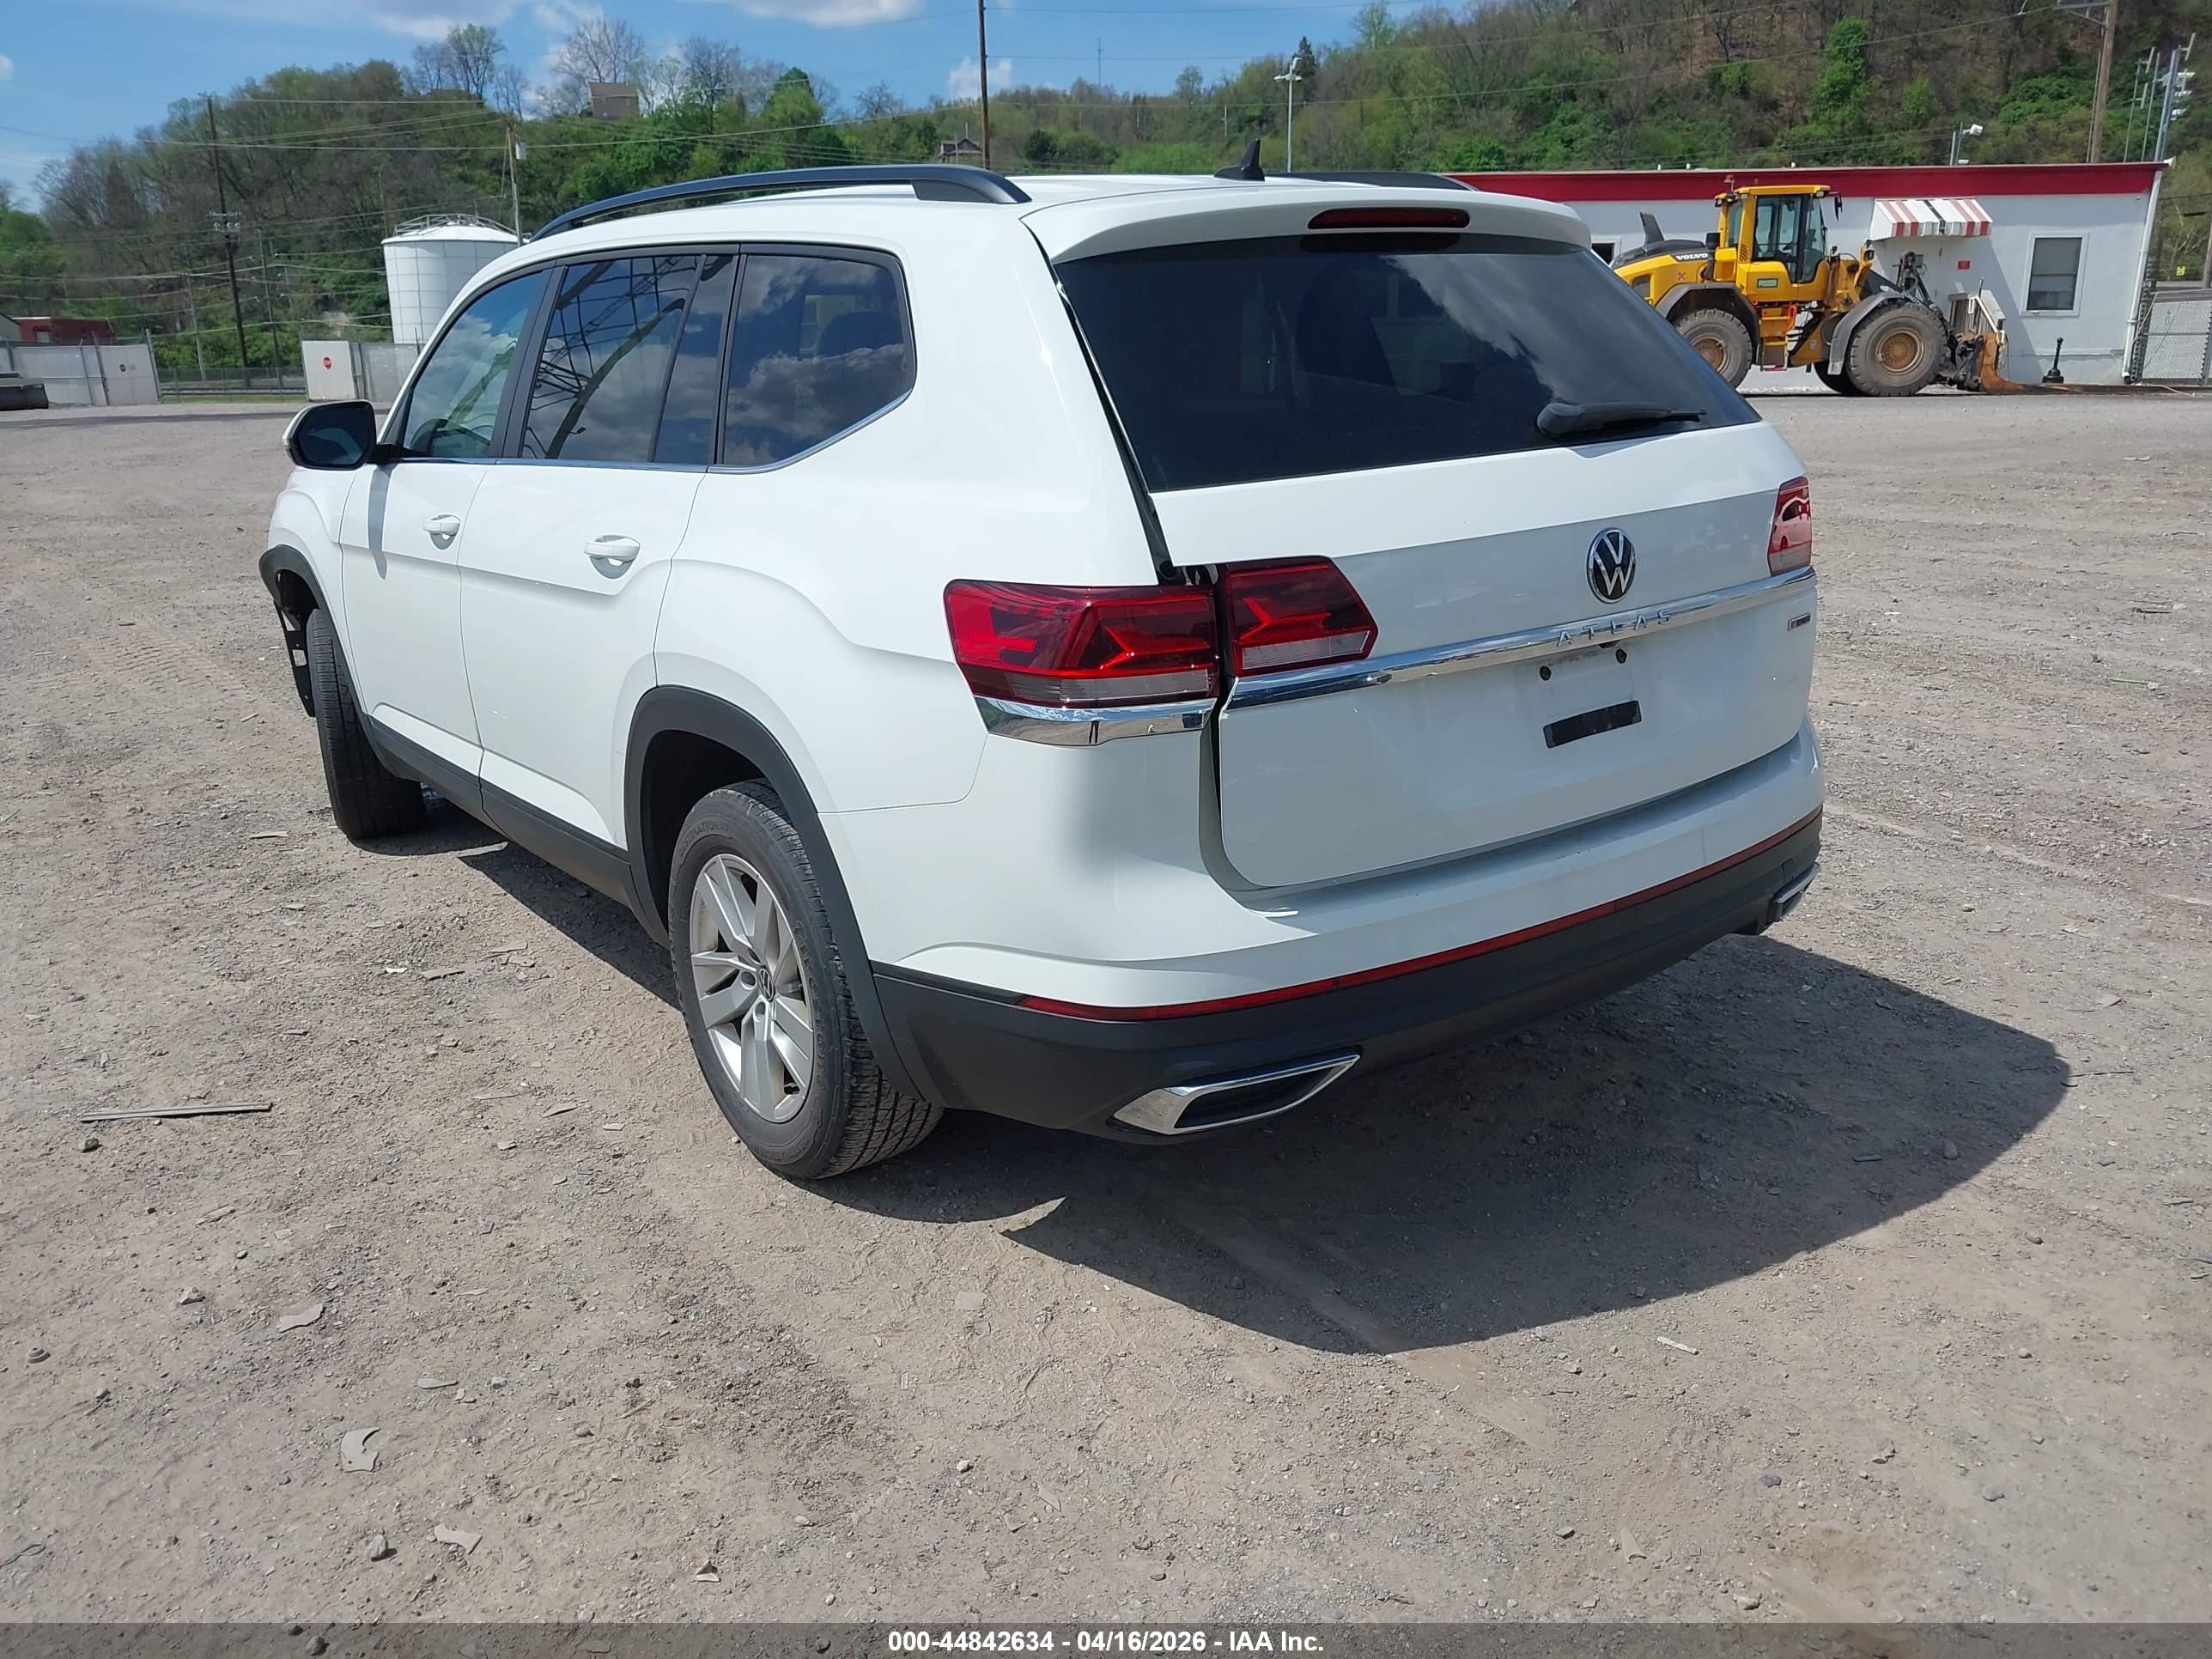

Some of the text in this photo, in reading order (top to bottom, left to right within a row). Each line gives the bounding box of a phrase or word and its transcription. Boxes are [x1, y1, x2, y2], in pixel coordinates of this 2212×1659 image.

[1675, 252, 1709, 261] VOLVO
[1589, 529, 1635, 599] VW
[1556, 610, 1671, 647] ATLAS
